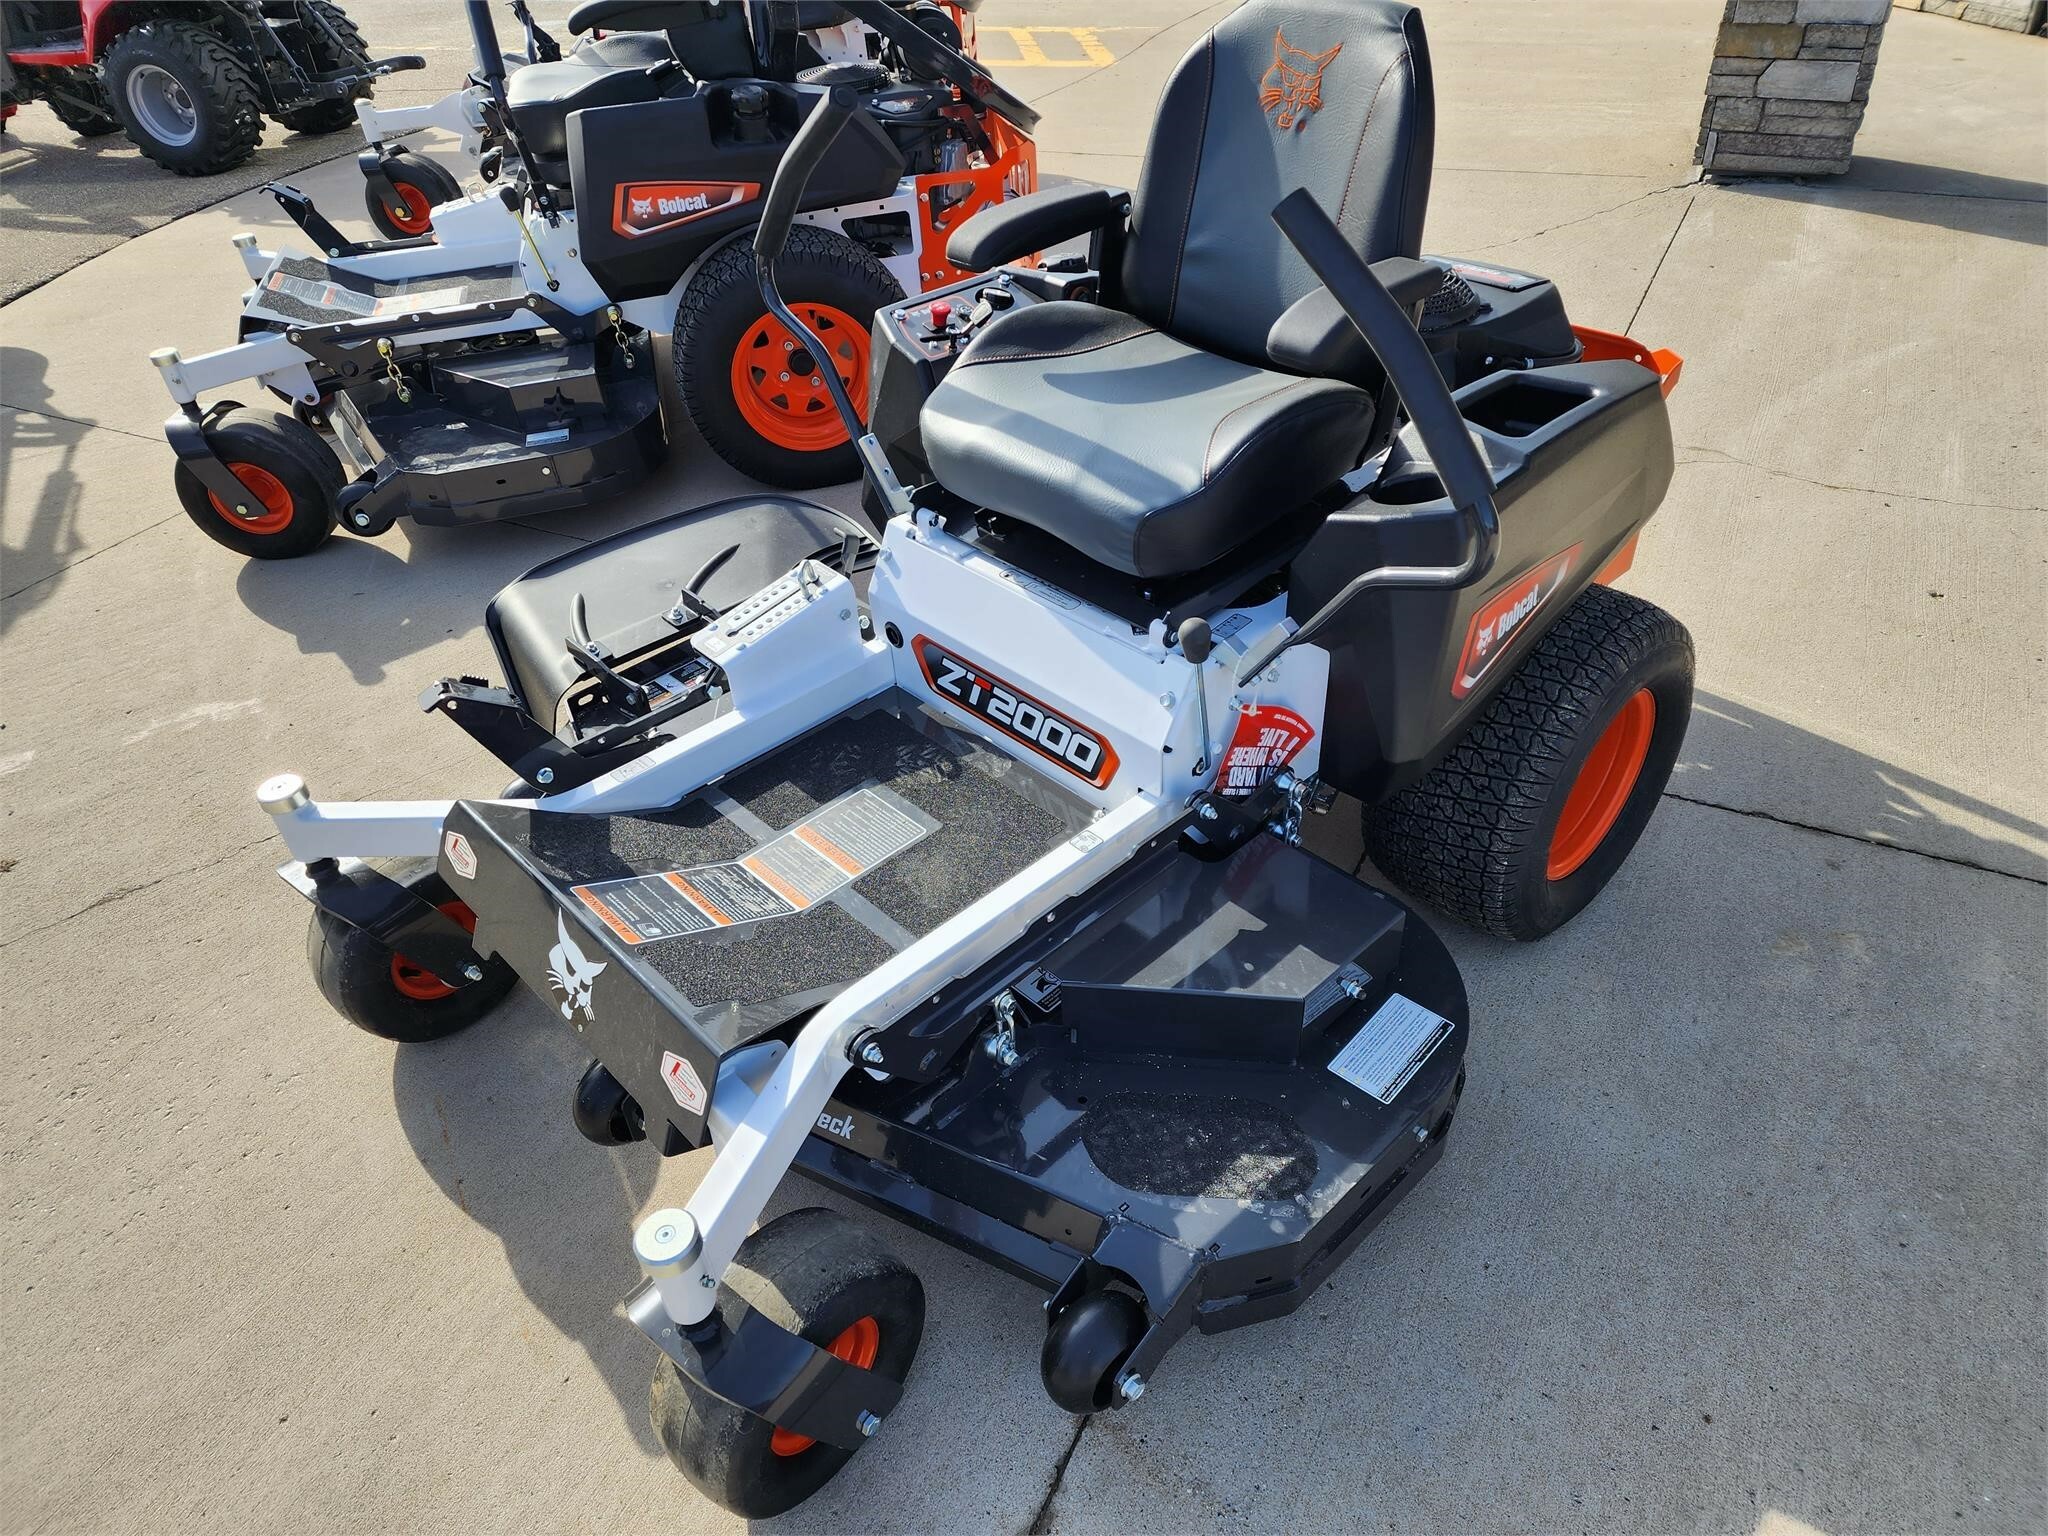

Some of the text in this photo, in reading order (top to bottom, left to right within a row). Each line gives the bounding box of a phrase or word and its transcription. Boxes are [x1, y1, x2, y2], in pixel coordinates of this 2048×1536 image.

[657, 192, 709, 215] Bobcat
[1497, 583, 1539, 640] Bobcat
[936, 656, 1101, 773] ZT2000
[1257, 727, 1301, 752] I LIVE
[1228, 746, 1289, 766] IS WHERE
[1228, 766, 1257, 787] YARD
[674, 881, 713, 910] WARNING
[583, 895, 622, 927] WARNING
